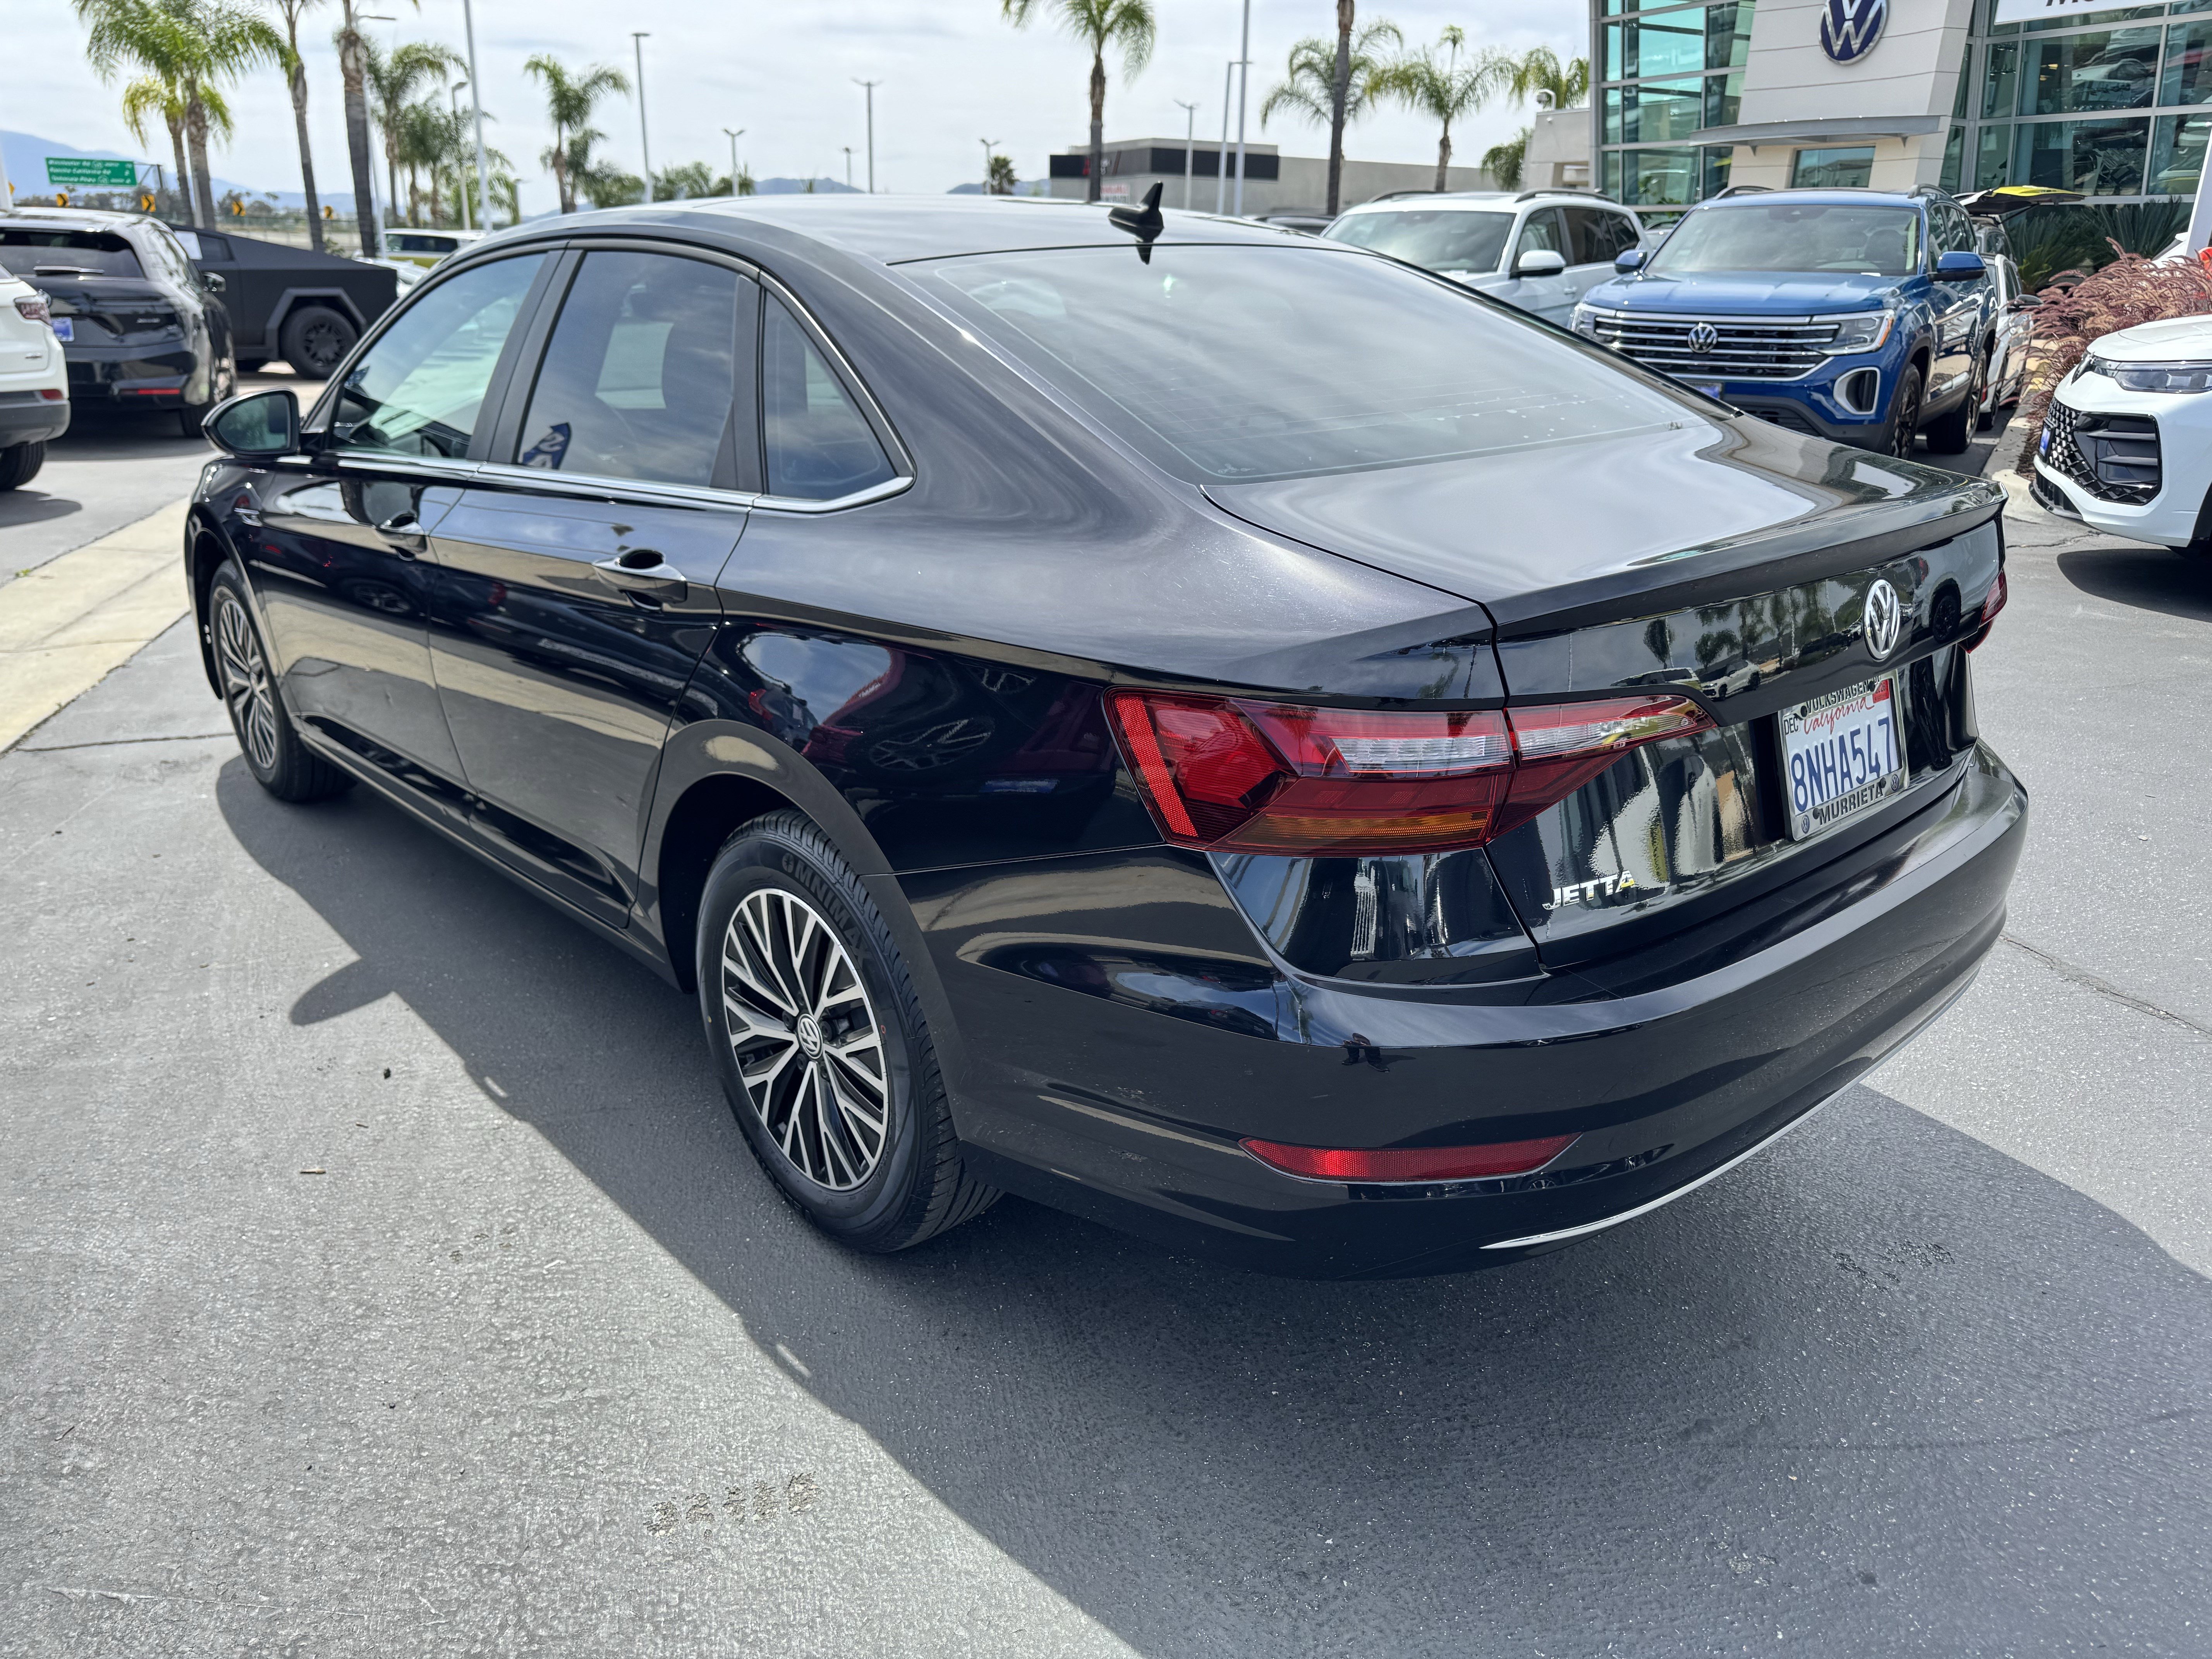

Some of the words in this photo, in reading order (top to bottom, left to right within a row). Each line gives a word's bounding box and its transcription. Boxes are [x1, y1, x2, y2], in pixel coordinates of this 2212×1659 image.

[1784, 717, 1799, 735] DEC
[1803, 697, 1874, 735] California
[1791, 716, 1891, 812] 8NHA547
[1819, 784, 1883, 825] MURRIETA
[1542, 870, 1635, 910] JETTA
